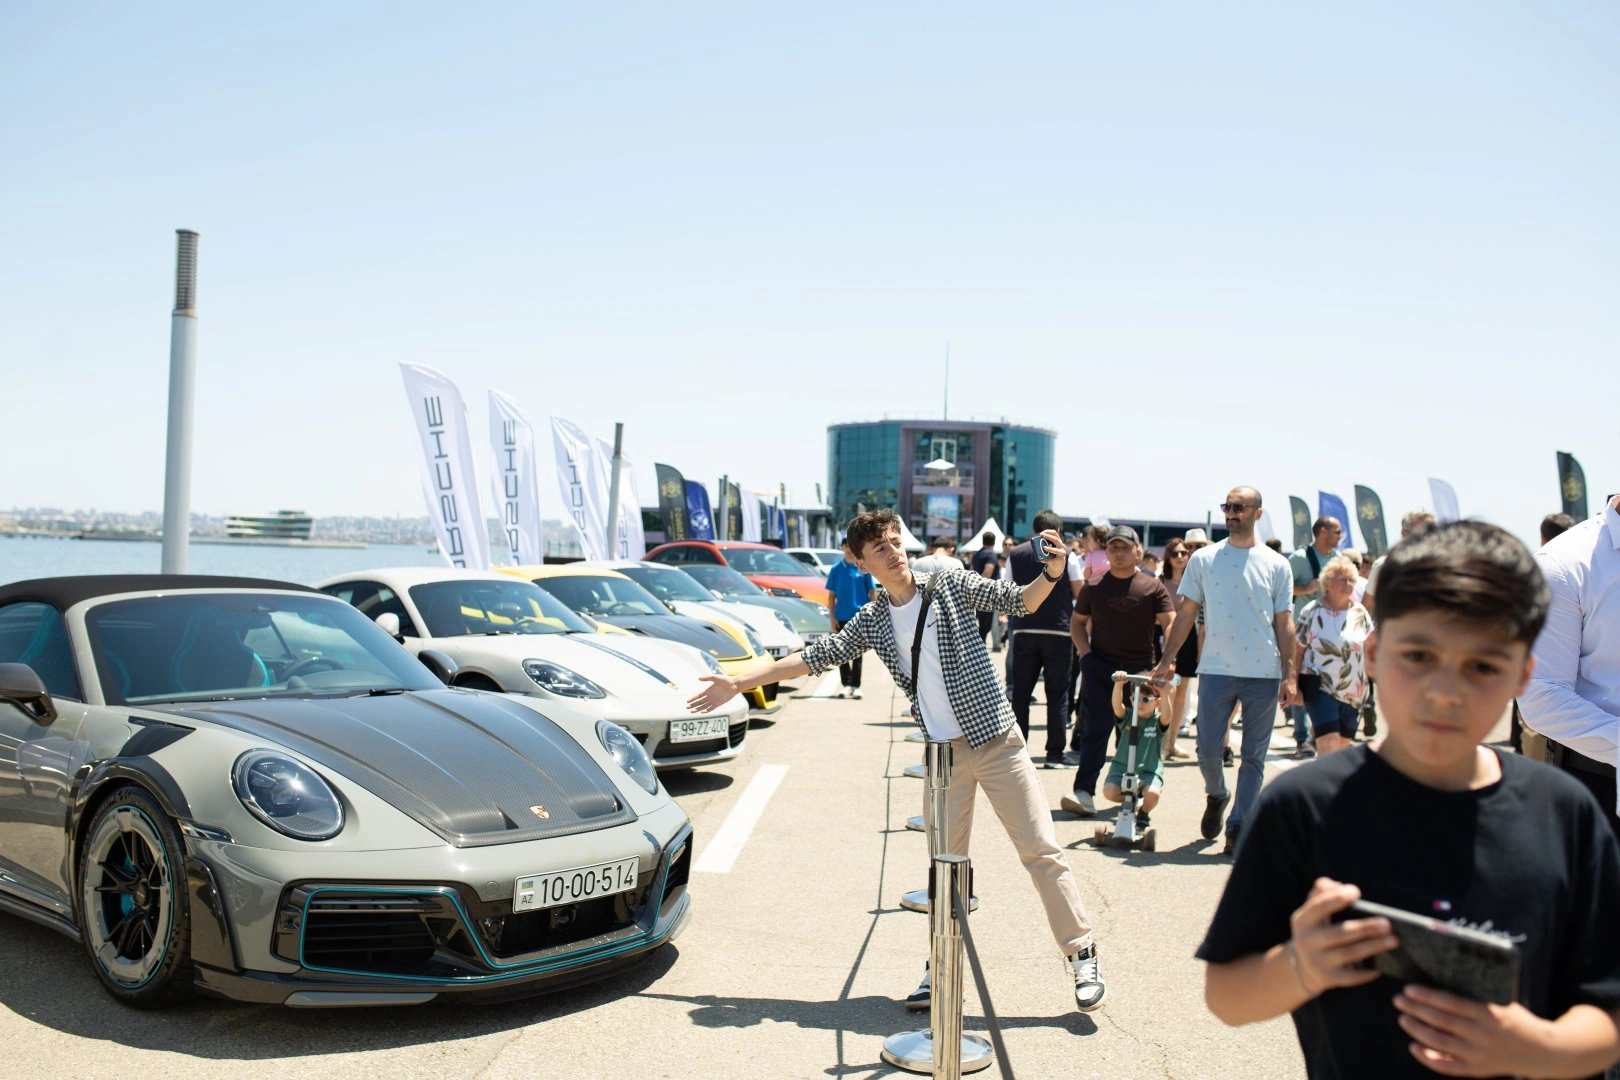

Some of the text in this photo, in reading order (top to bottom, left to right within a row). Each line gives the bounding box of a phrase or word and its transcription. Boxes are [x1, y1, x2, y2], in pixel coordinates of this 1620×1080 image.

[681, 718, 727, 737] 99-ZZ-400
[541, 862, 635, 904] 10-00-514
[520, 894, 533, 905] AZ
